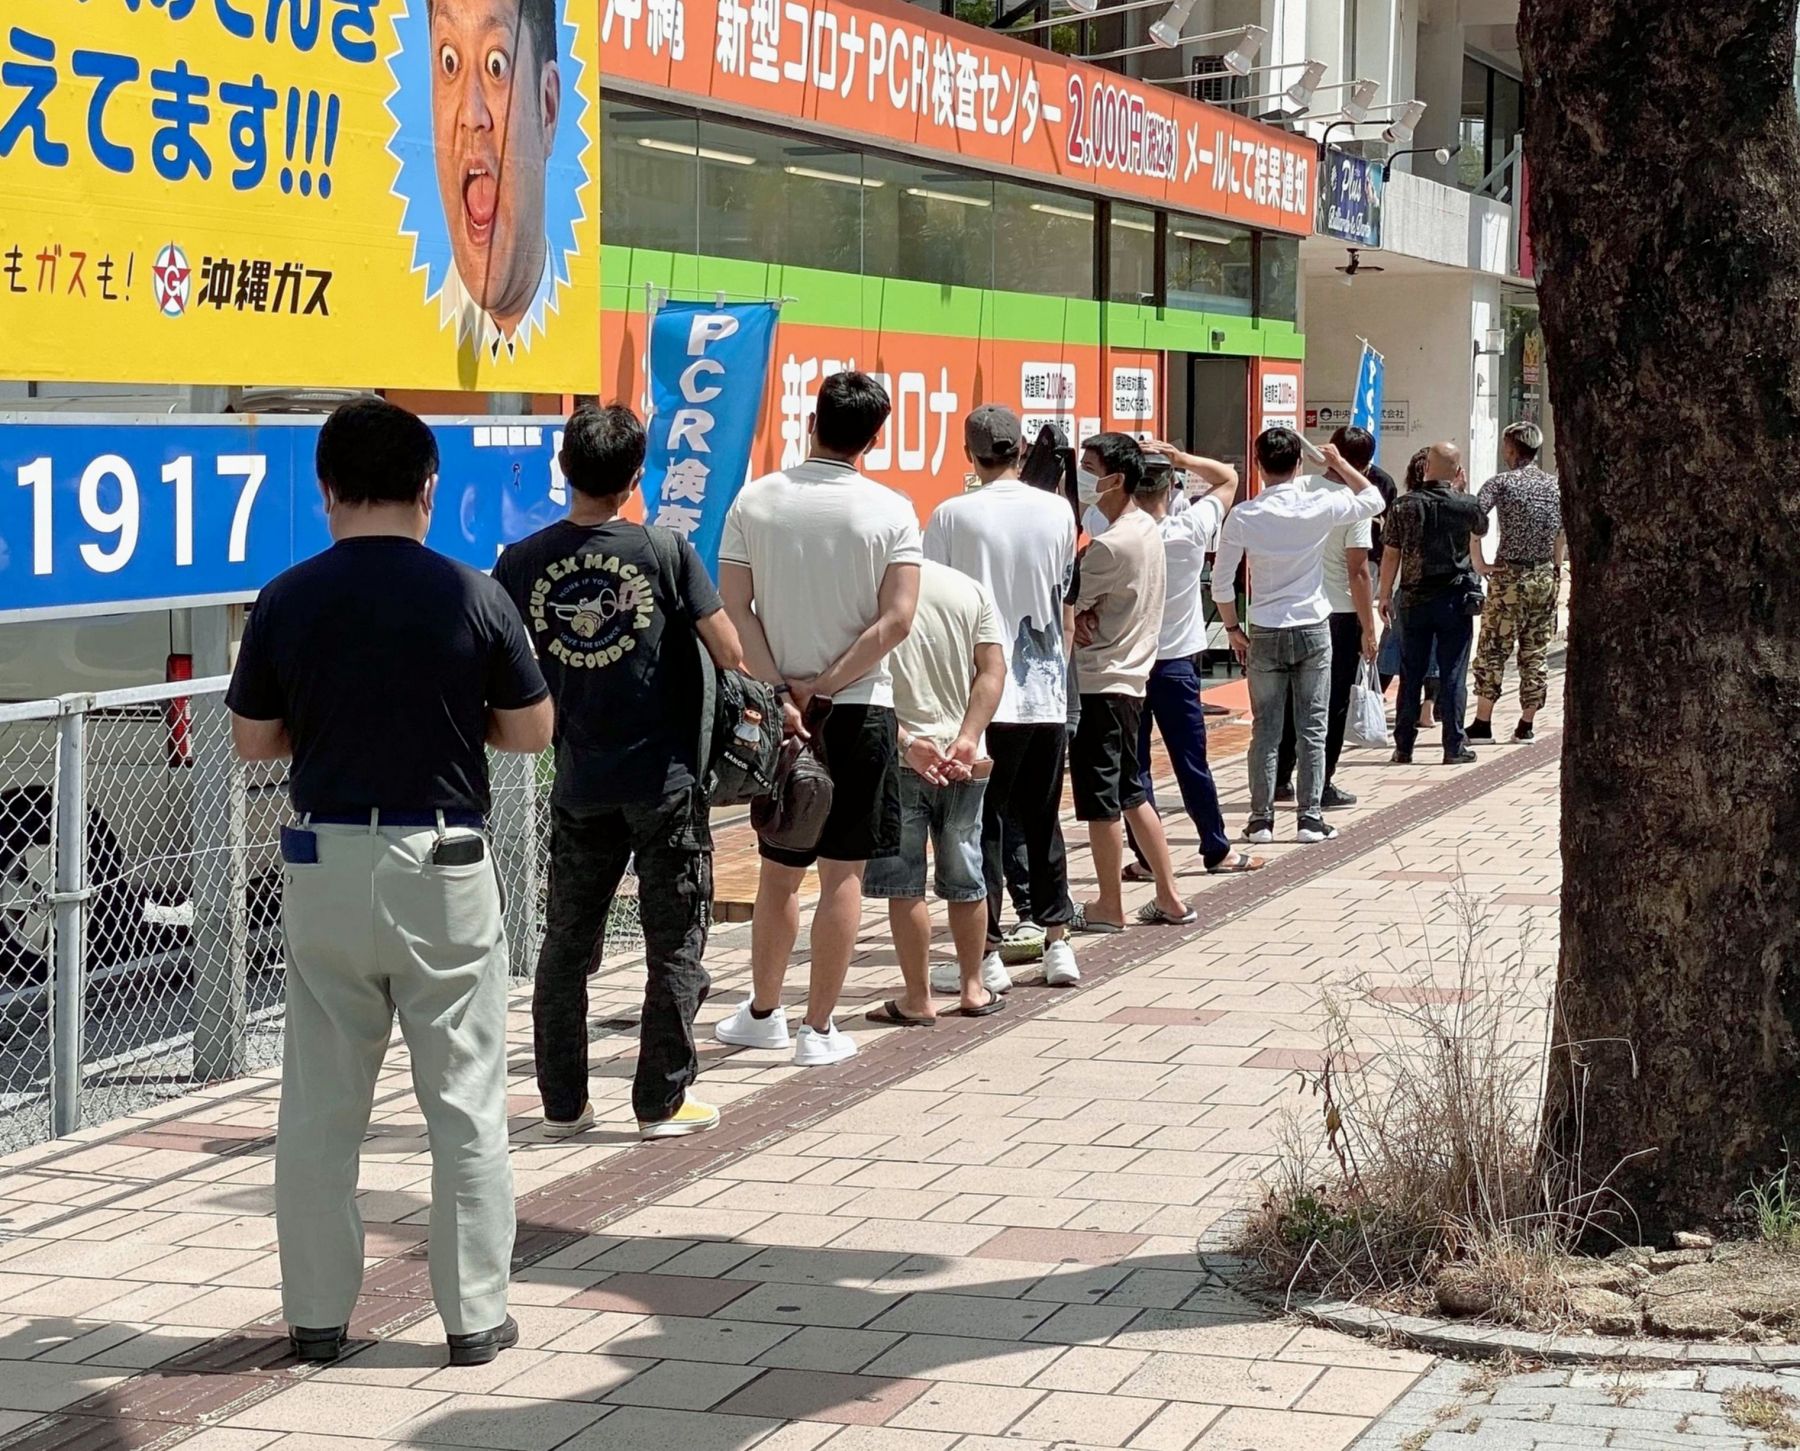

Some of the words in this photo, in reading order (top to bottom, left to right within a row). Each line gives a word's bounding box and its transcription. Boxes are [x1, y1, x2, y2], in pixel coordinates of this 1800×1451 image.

[602, 0, 686, 62] 沖縄
[717, 0, 1061, 144] 新型コロナPCR検査センター
[1184, 120, 1309, 216] メールにて結果通知
[196, 255, 333, 316] 沖縄ガス
[17, 453, 267, 575] 1917
[529, 578, 551, 633] DEUS
[545, 556, 580, 581] EX
[583, 553, 654, 630] MACHINA
[581, 578, 590, 586] IF
[592, 578, 610, 587] YOU
[548, 635, 636, 669] RECORDS
[560, 631, 577, 646] LOVE
[579, 641, 593, 649] THE
[594, 625, 622, 648] SILENCE
